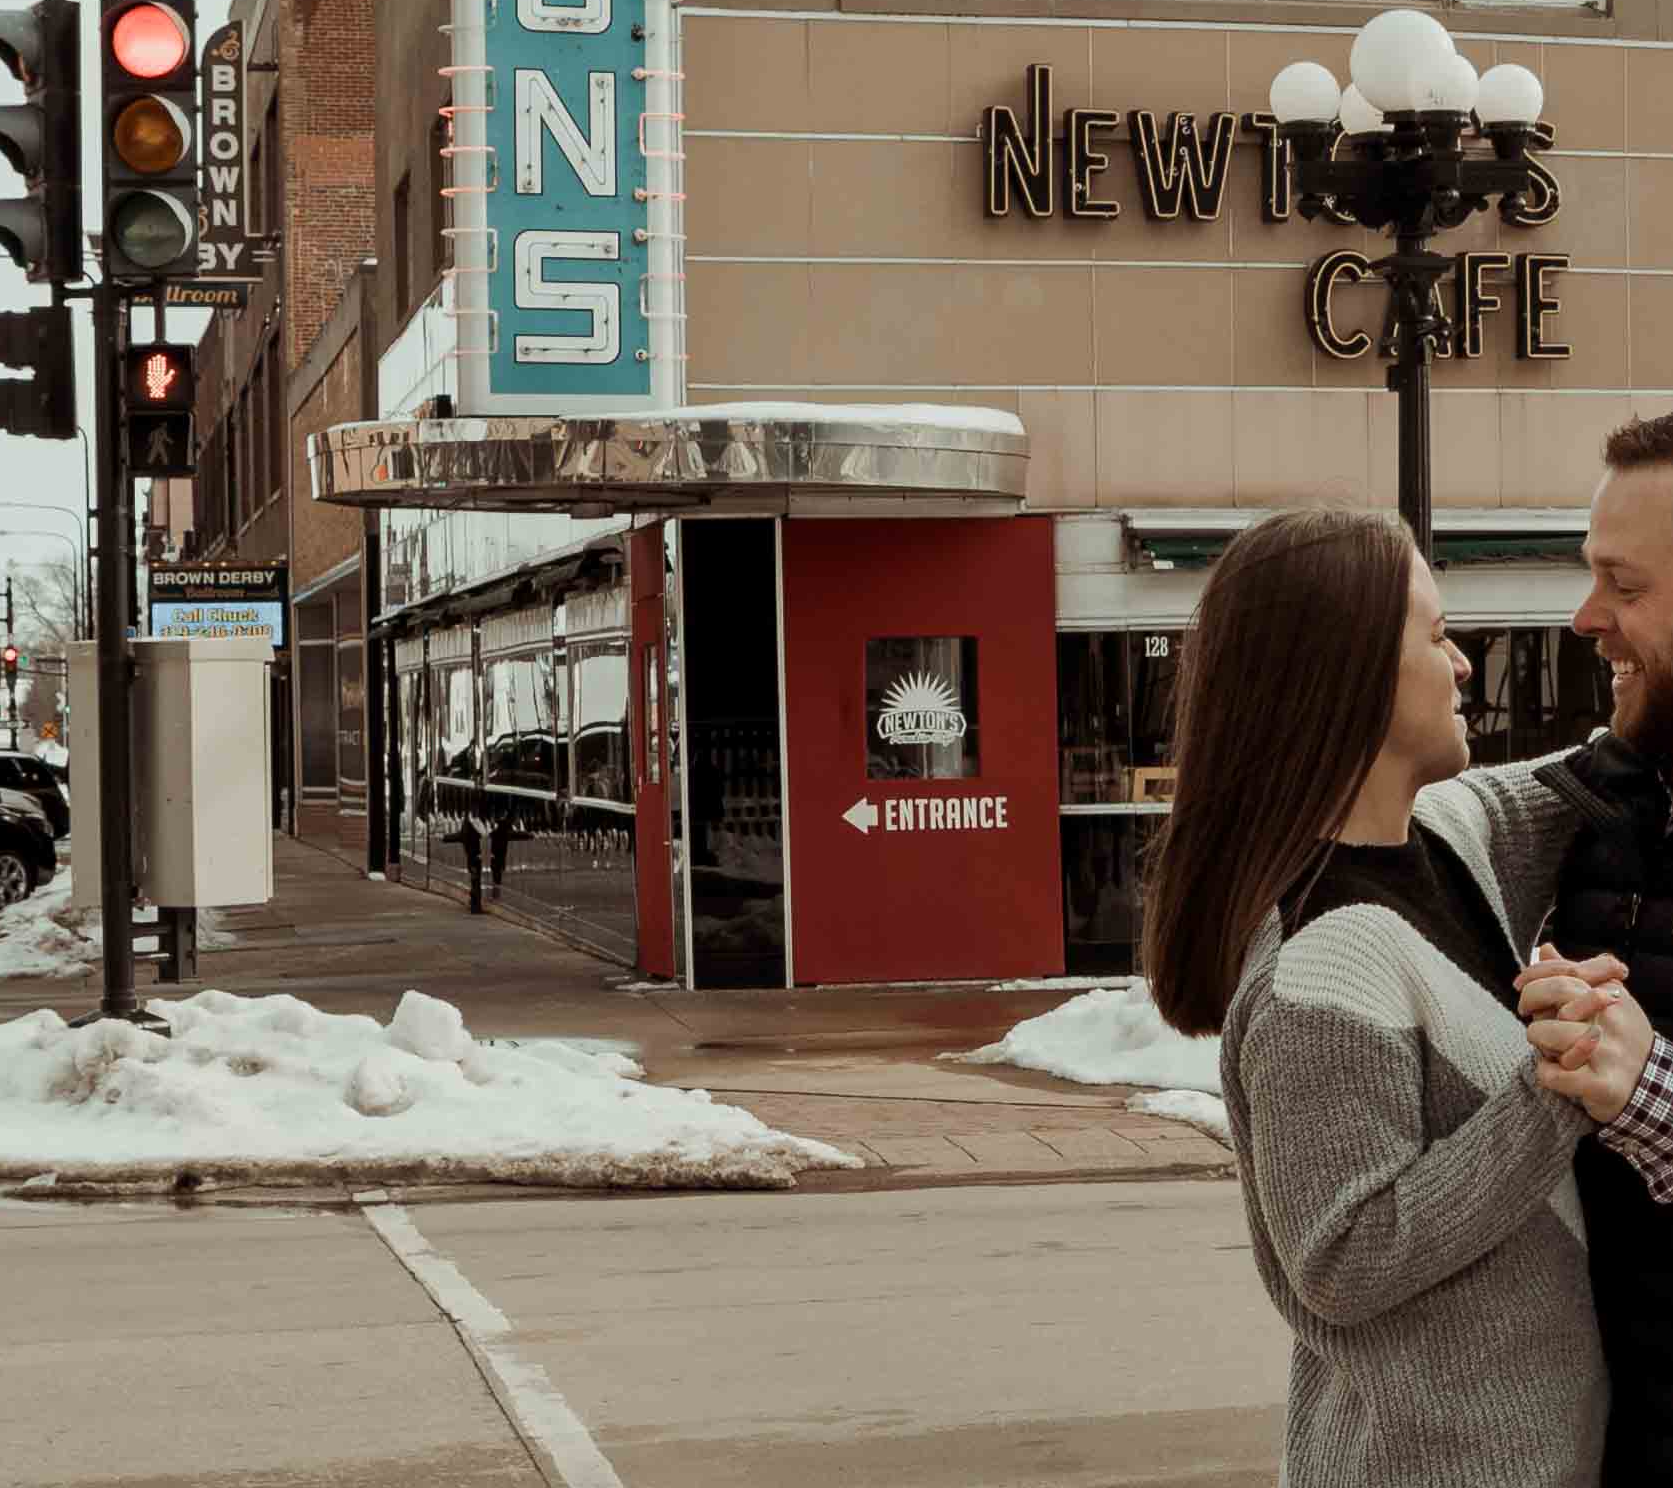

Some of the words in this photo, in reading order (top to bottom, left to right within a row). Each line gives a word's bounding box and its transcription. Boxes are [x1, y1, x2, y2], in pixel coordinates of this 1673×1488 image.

[208, 64, 239, 227] BROWN
[152, 570, 215, 585] BROWN
[218, 570, 276, 585] DERBY
[1144, 635, 1169, 658] 128
[884, 711, 959, 734] NEWTON'S
[884, 795, 1009, 832] ENTRANCE
